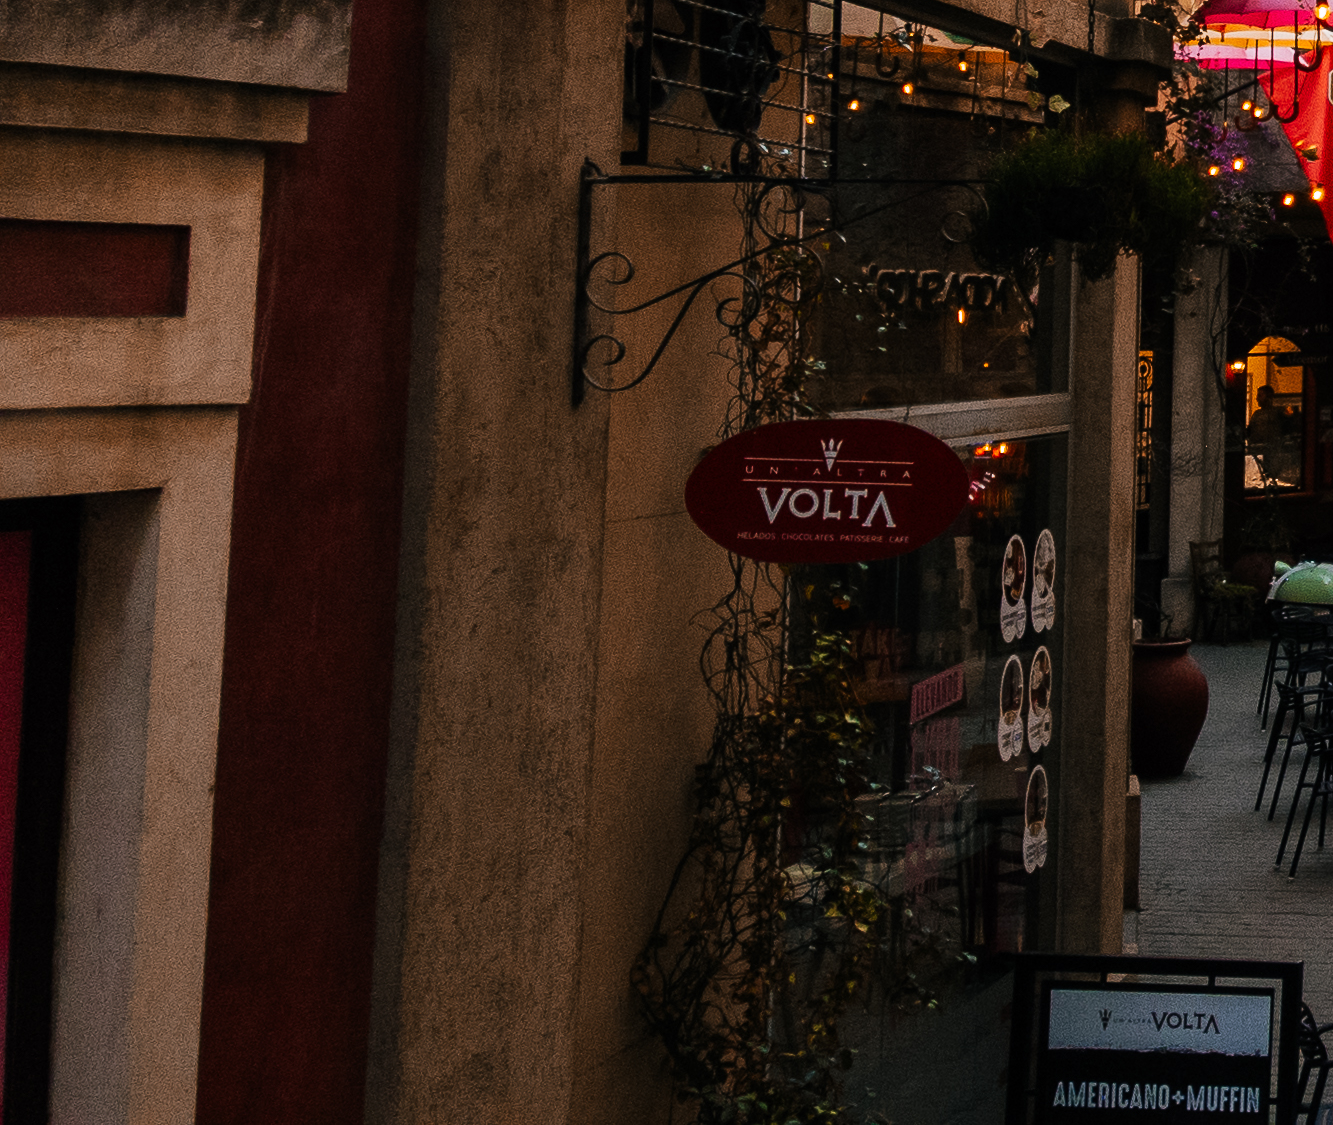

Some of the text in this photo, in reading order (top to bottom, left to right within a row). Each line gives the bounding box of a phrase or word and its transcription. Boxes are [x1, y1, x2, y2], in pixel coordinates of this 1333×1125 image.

[756, 486, 897, 529] VOLTA
[736, 531, 776, 541] HELADOS
[781, 532, 835, 543] CHOCOLATES
[1150, 1010, 1221, 1035] VOLTA
